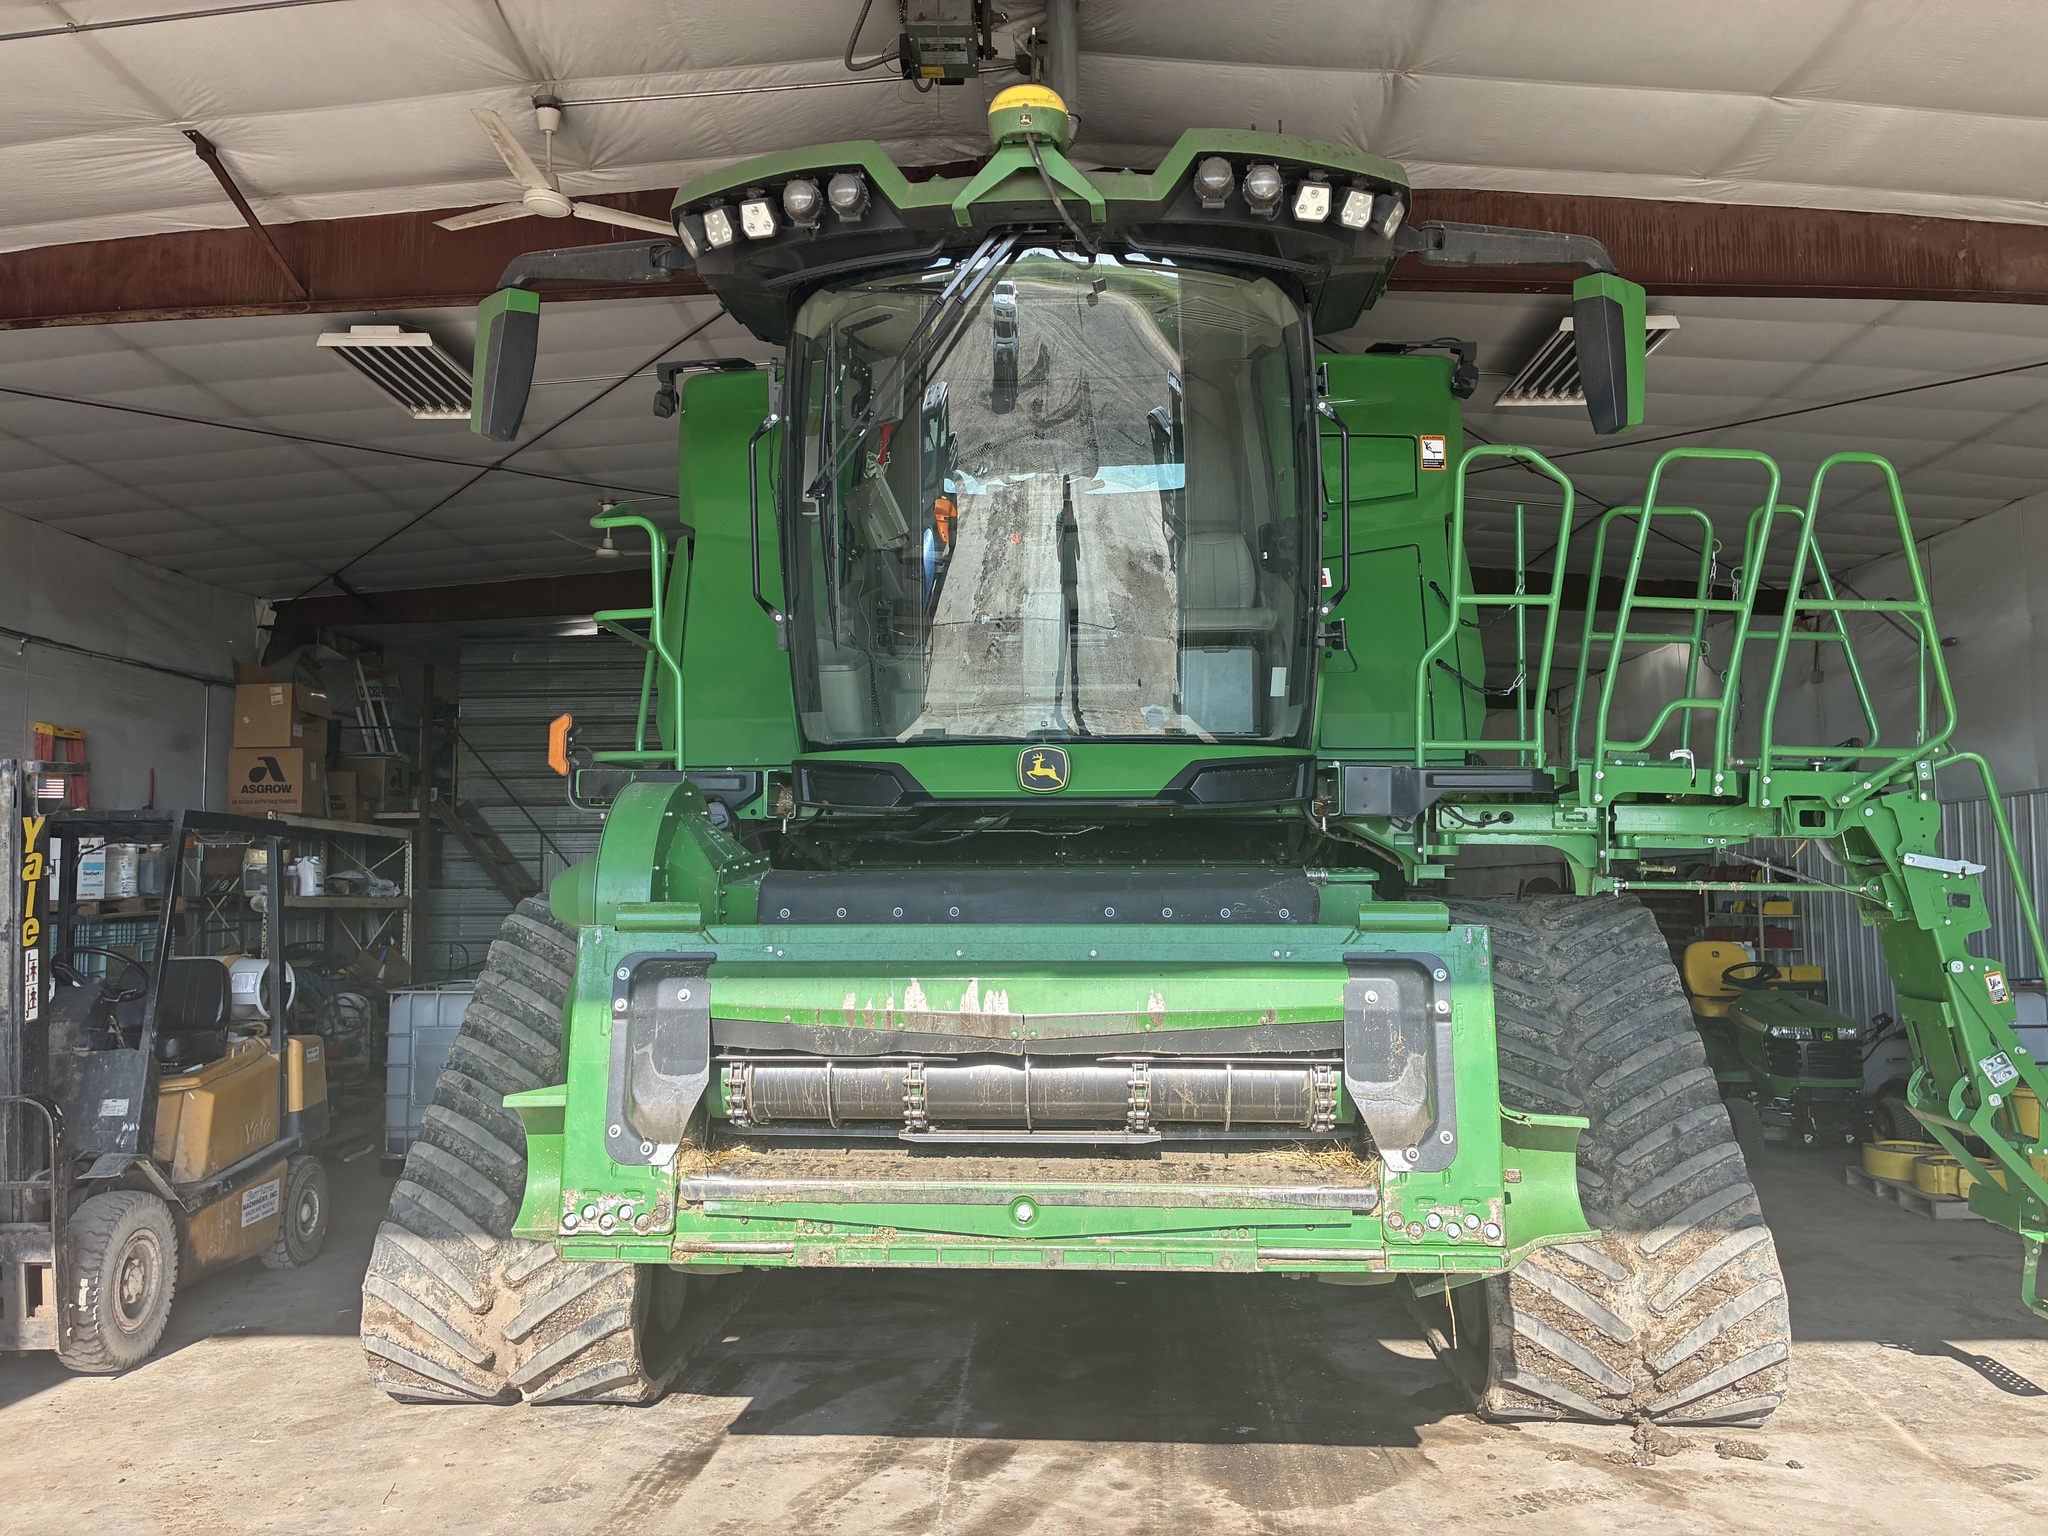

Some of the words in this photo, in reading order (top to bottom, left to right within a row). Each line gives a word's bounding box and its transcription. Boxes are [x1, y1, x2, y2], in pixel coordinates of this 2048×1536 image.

[241, 784, 292, 794] ASGROW
[22, 816, 46, 947] Yale
[245, 1116, 271, 1145] Yale
